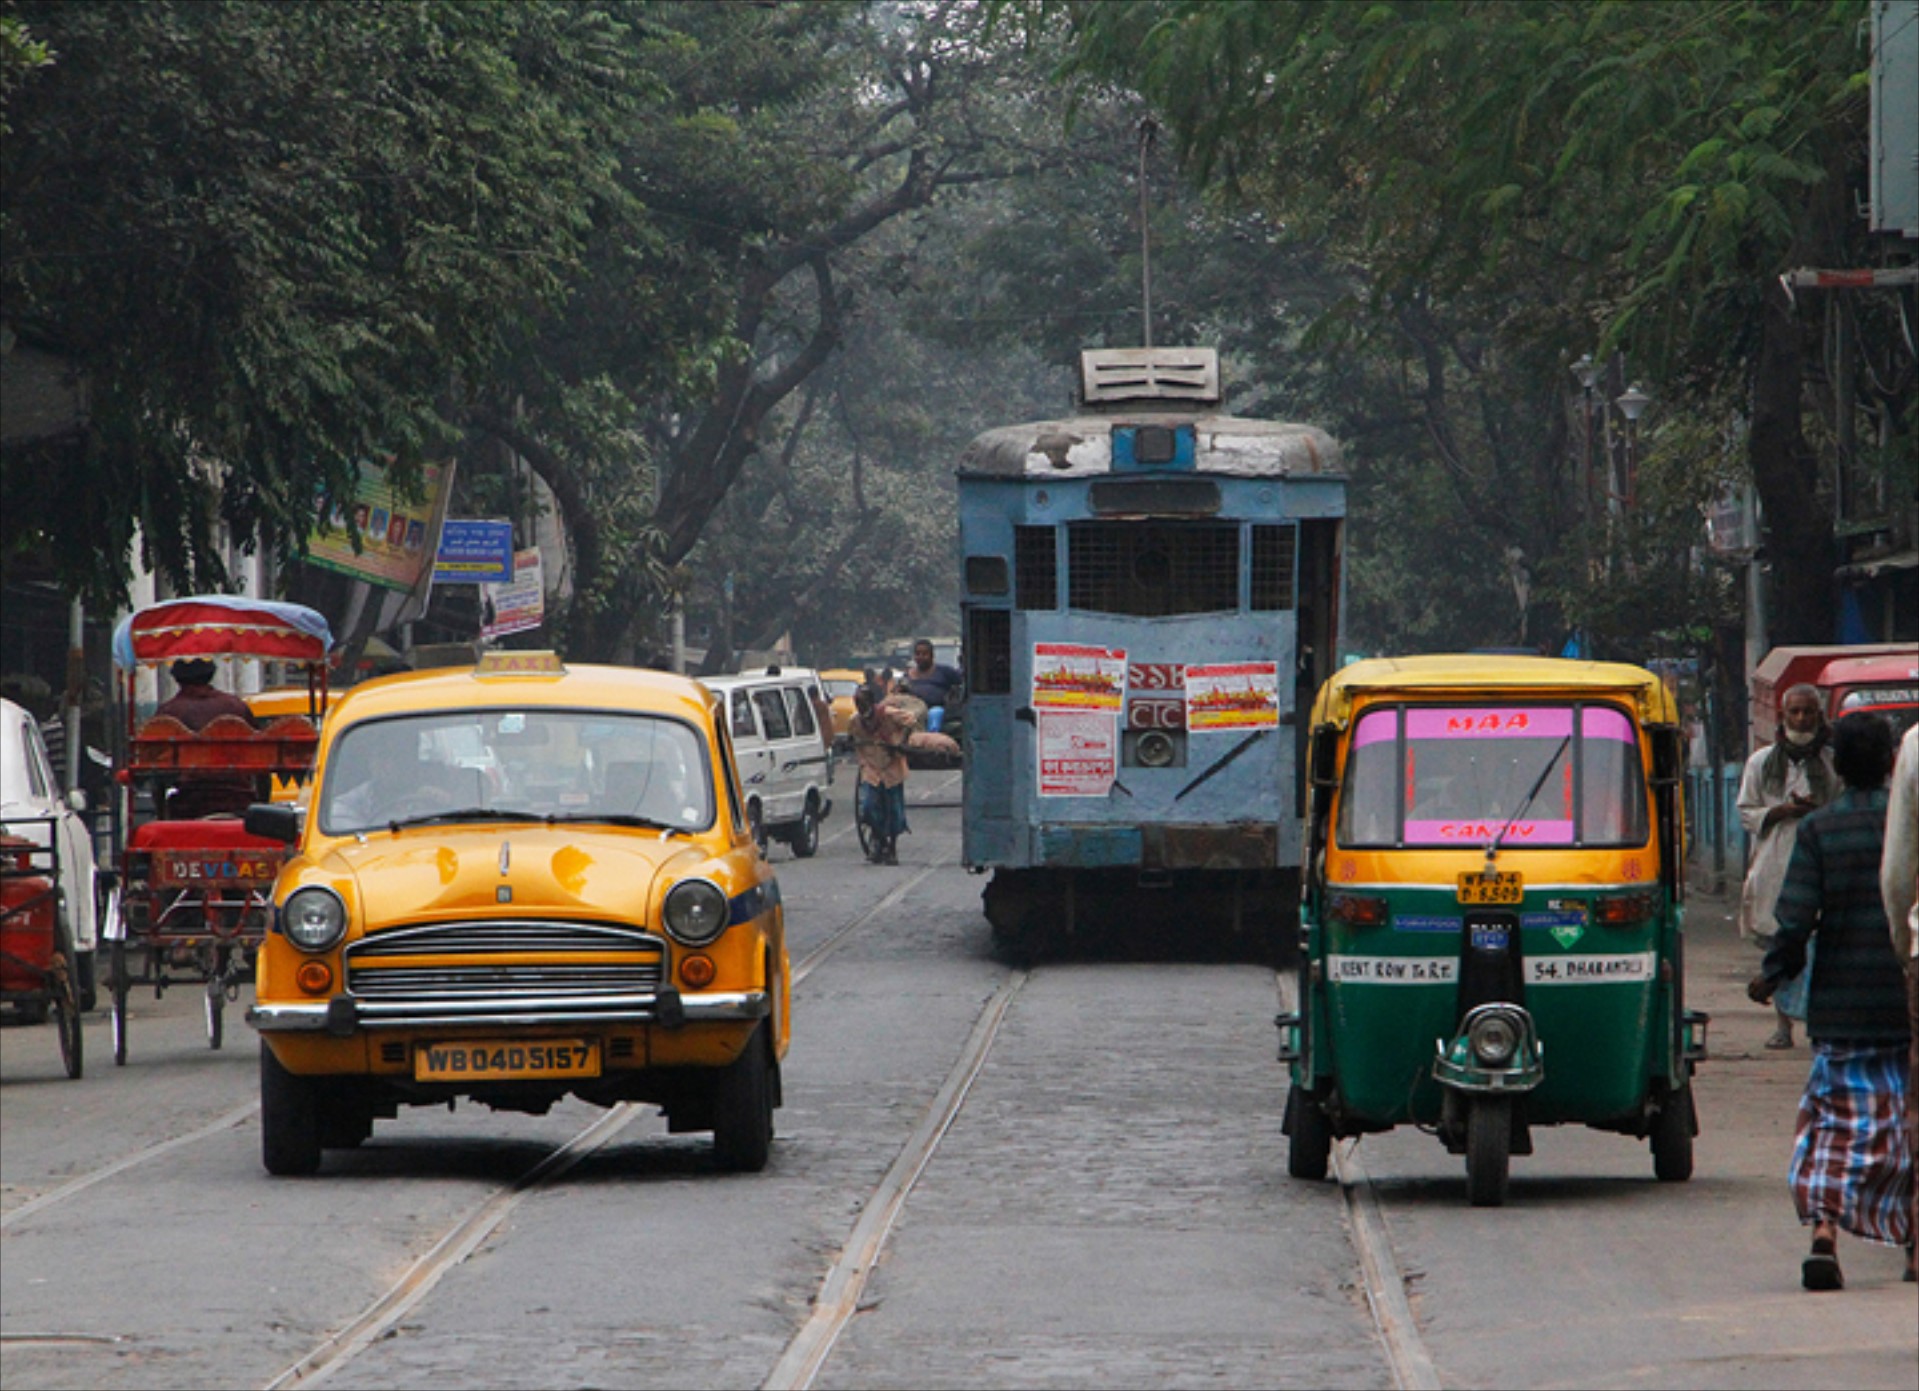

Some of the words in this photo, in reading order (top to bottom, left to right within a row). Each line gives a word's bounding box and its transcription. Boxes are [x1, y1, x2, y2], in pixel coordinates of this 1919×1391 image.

[489, 656, 551, 669] TAXI
[1447, 713, 1529, 732] MAA
[173, 862, 268, 877] DEVDAS
